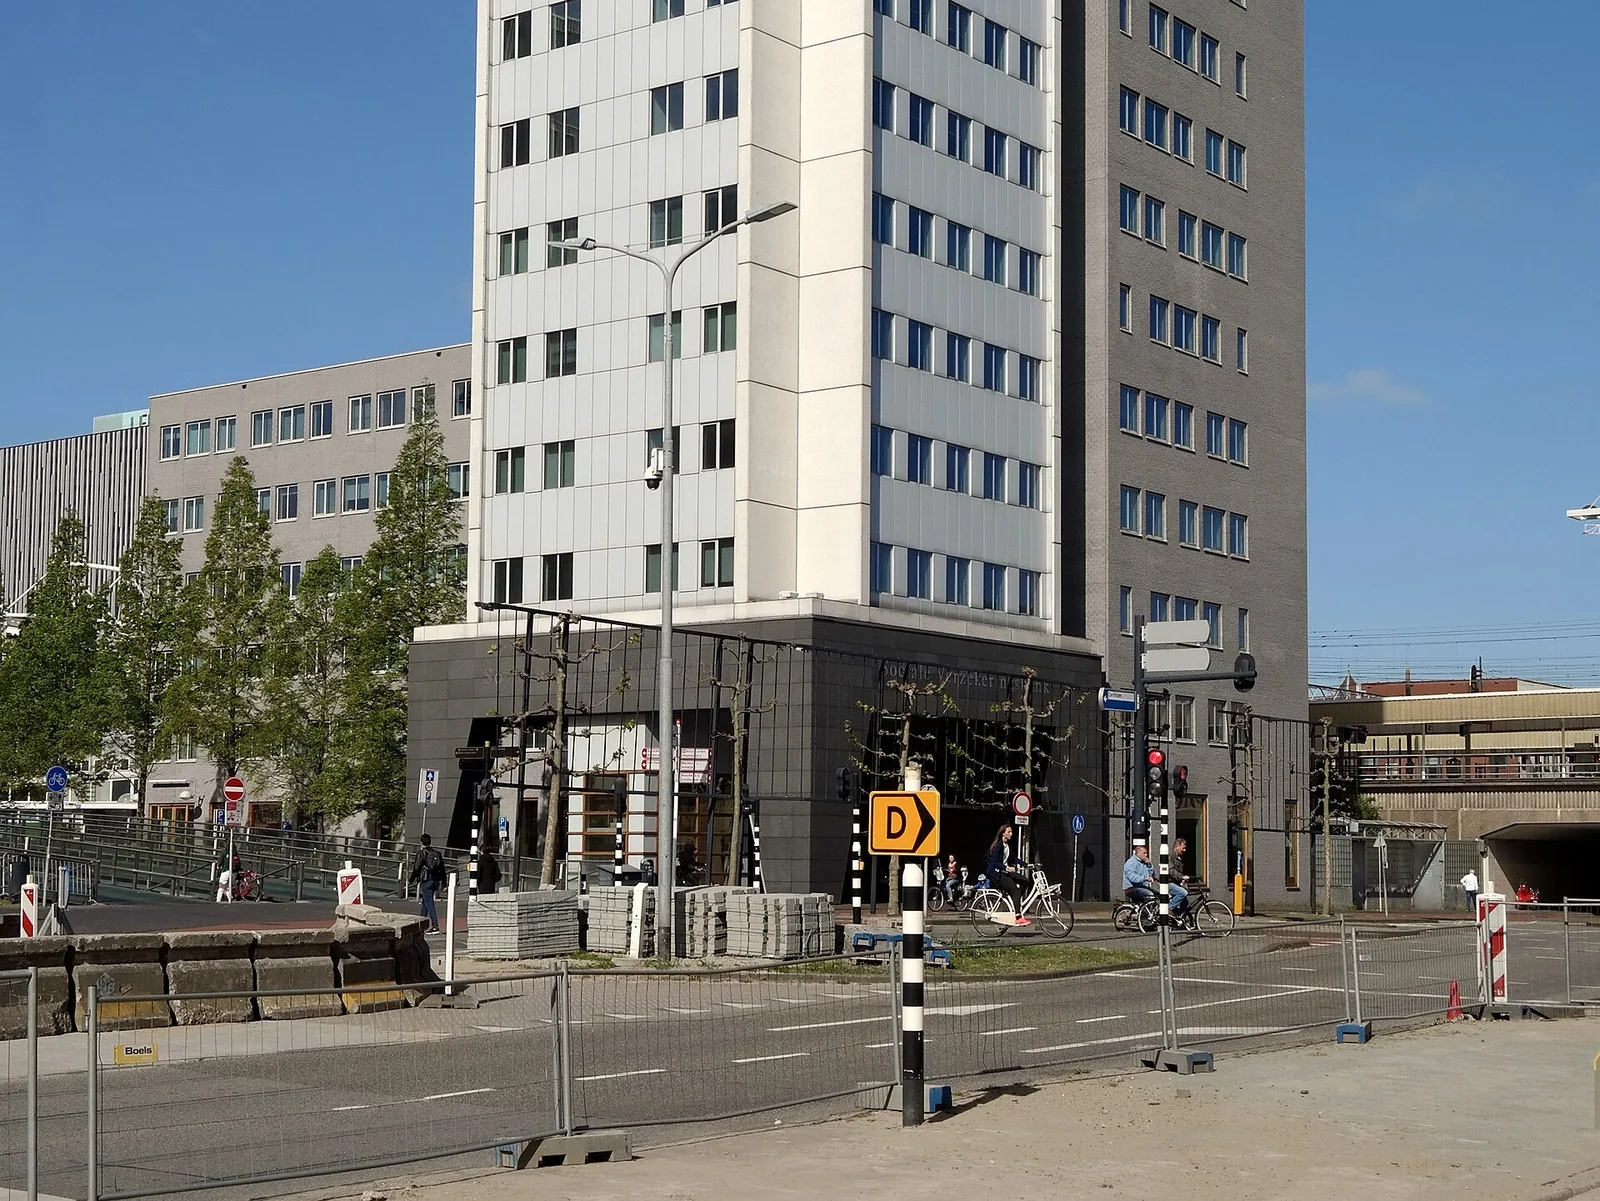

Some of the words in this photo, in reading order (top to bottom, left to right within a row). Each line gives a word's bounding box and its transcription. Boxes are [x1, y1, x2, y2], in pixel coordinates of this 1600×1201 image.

[218, 810, 224, 818] P
[886, 805, 907, 840] D
[125, 1046, 153, 1055] Boels
